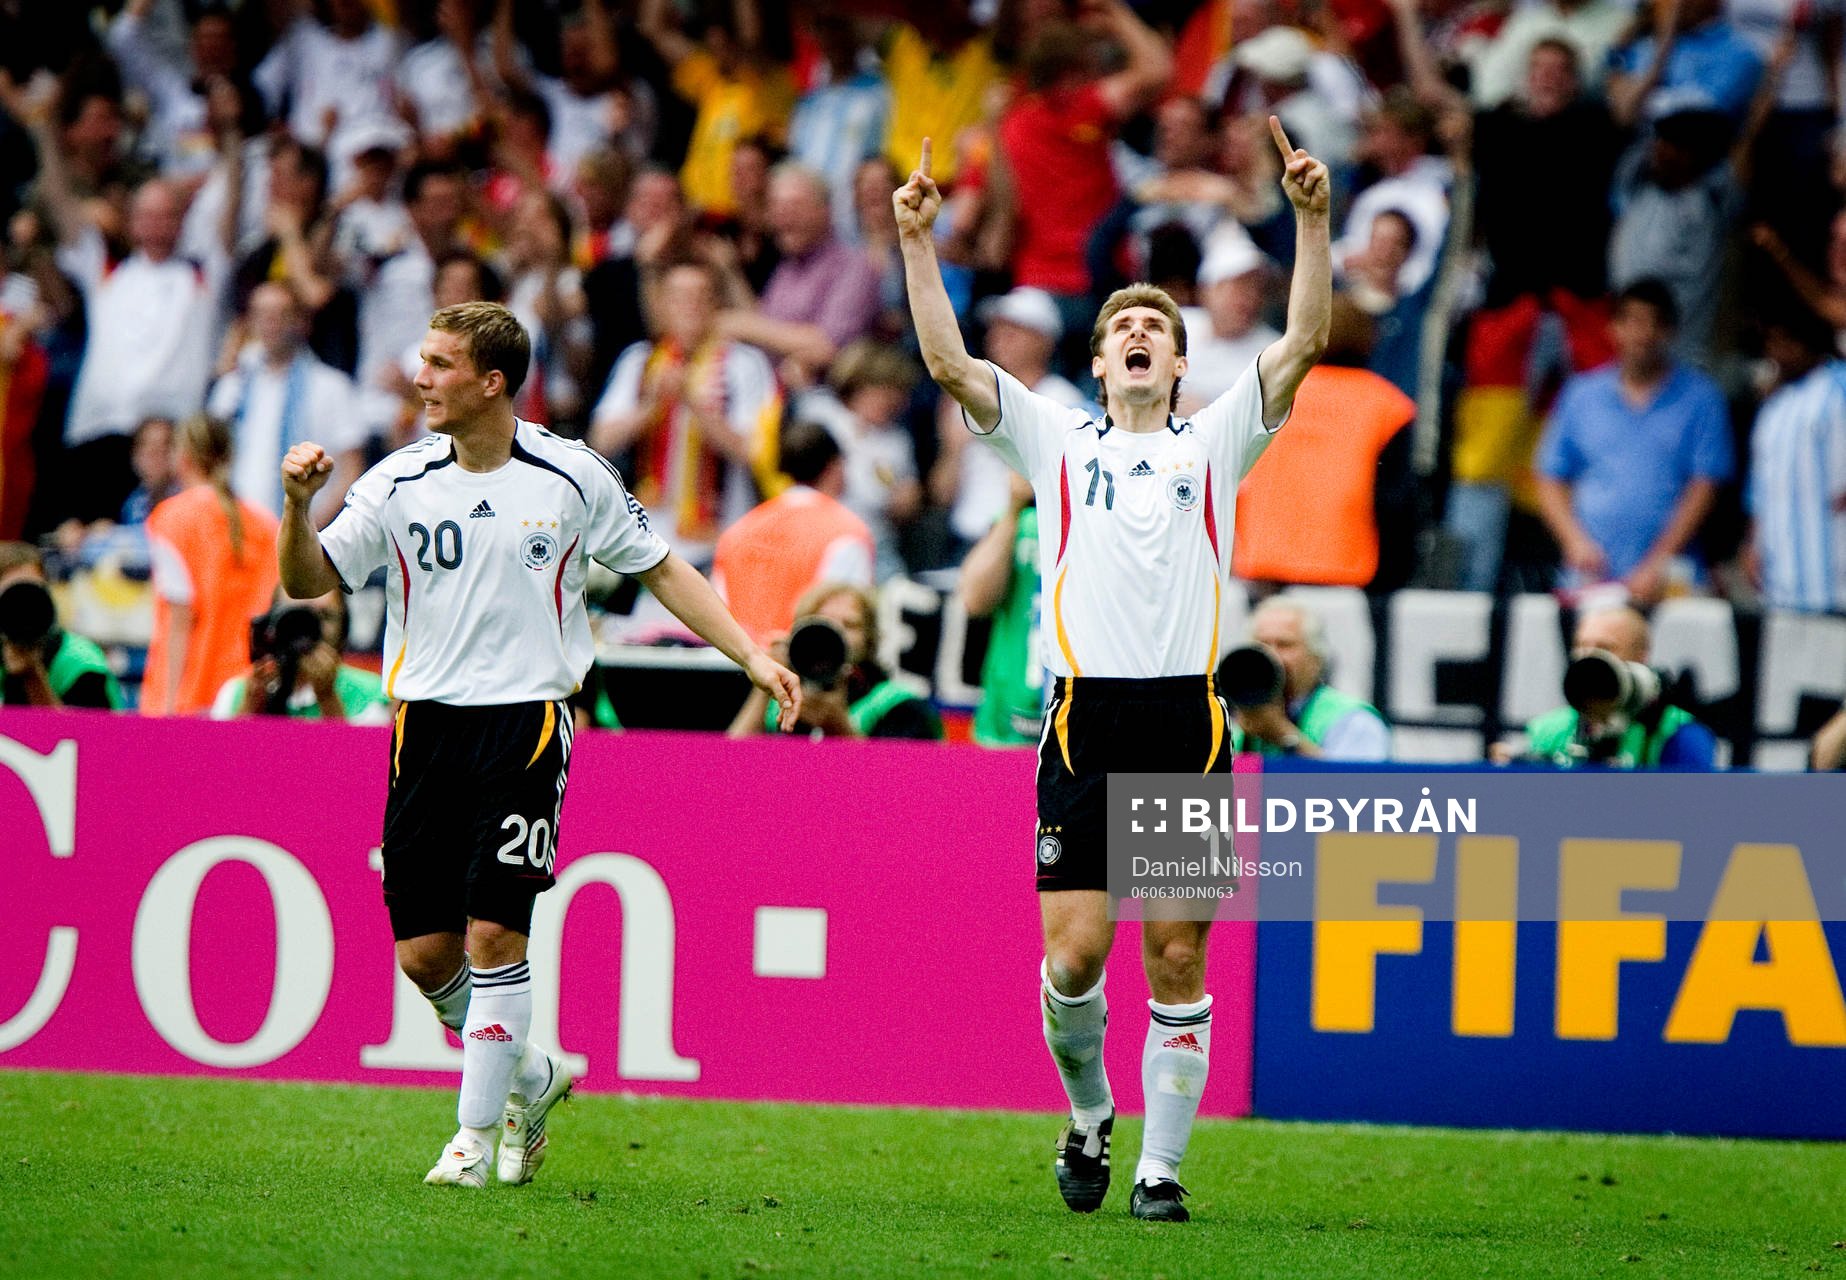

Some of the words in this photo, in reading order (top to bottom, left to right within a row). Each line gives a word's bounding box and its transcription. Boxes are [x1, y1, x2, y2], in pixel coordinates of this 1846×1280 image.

[1084, 457, 1115, 511] 11
[408, 520, 463, 572] 20
[497, 814, 551, 868] 20
[1311, 830, 1846, 1048] FIFA
[469, 1030, 513, 1042] adidas
[1162, 1040, 1204, 1054] adidas
